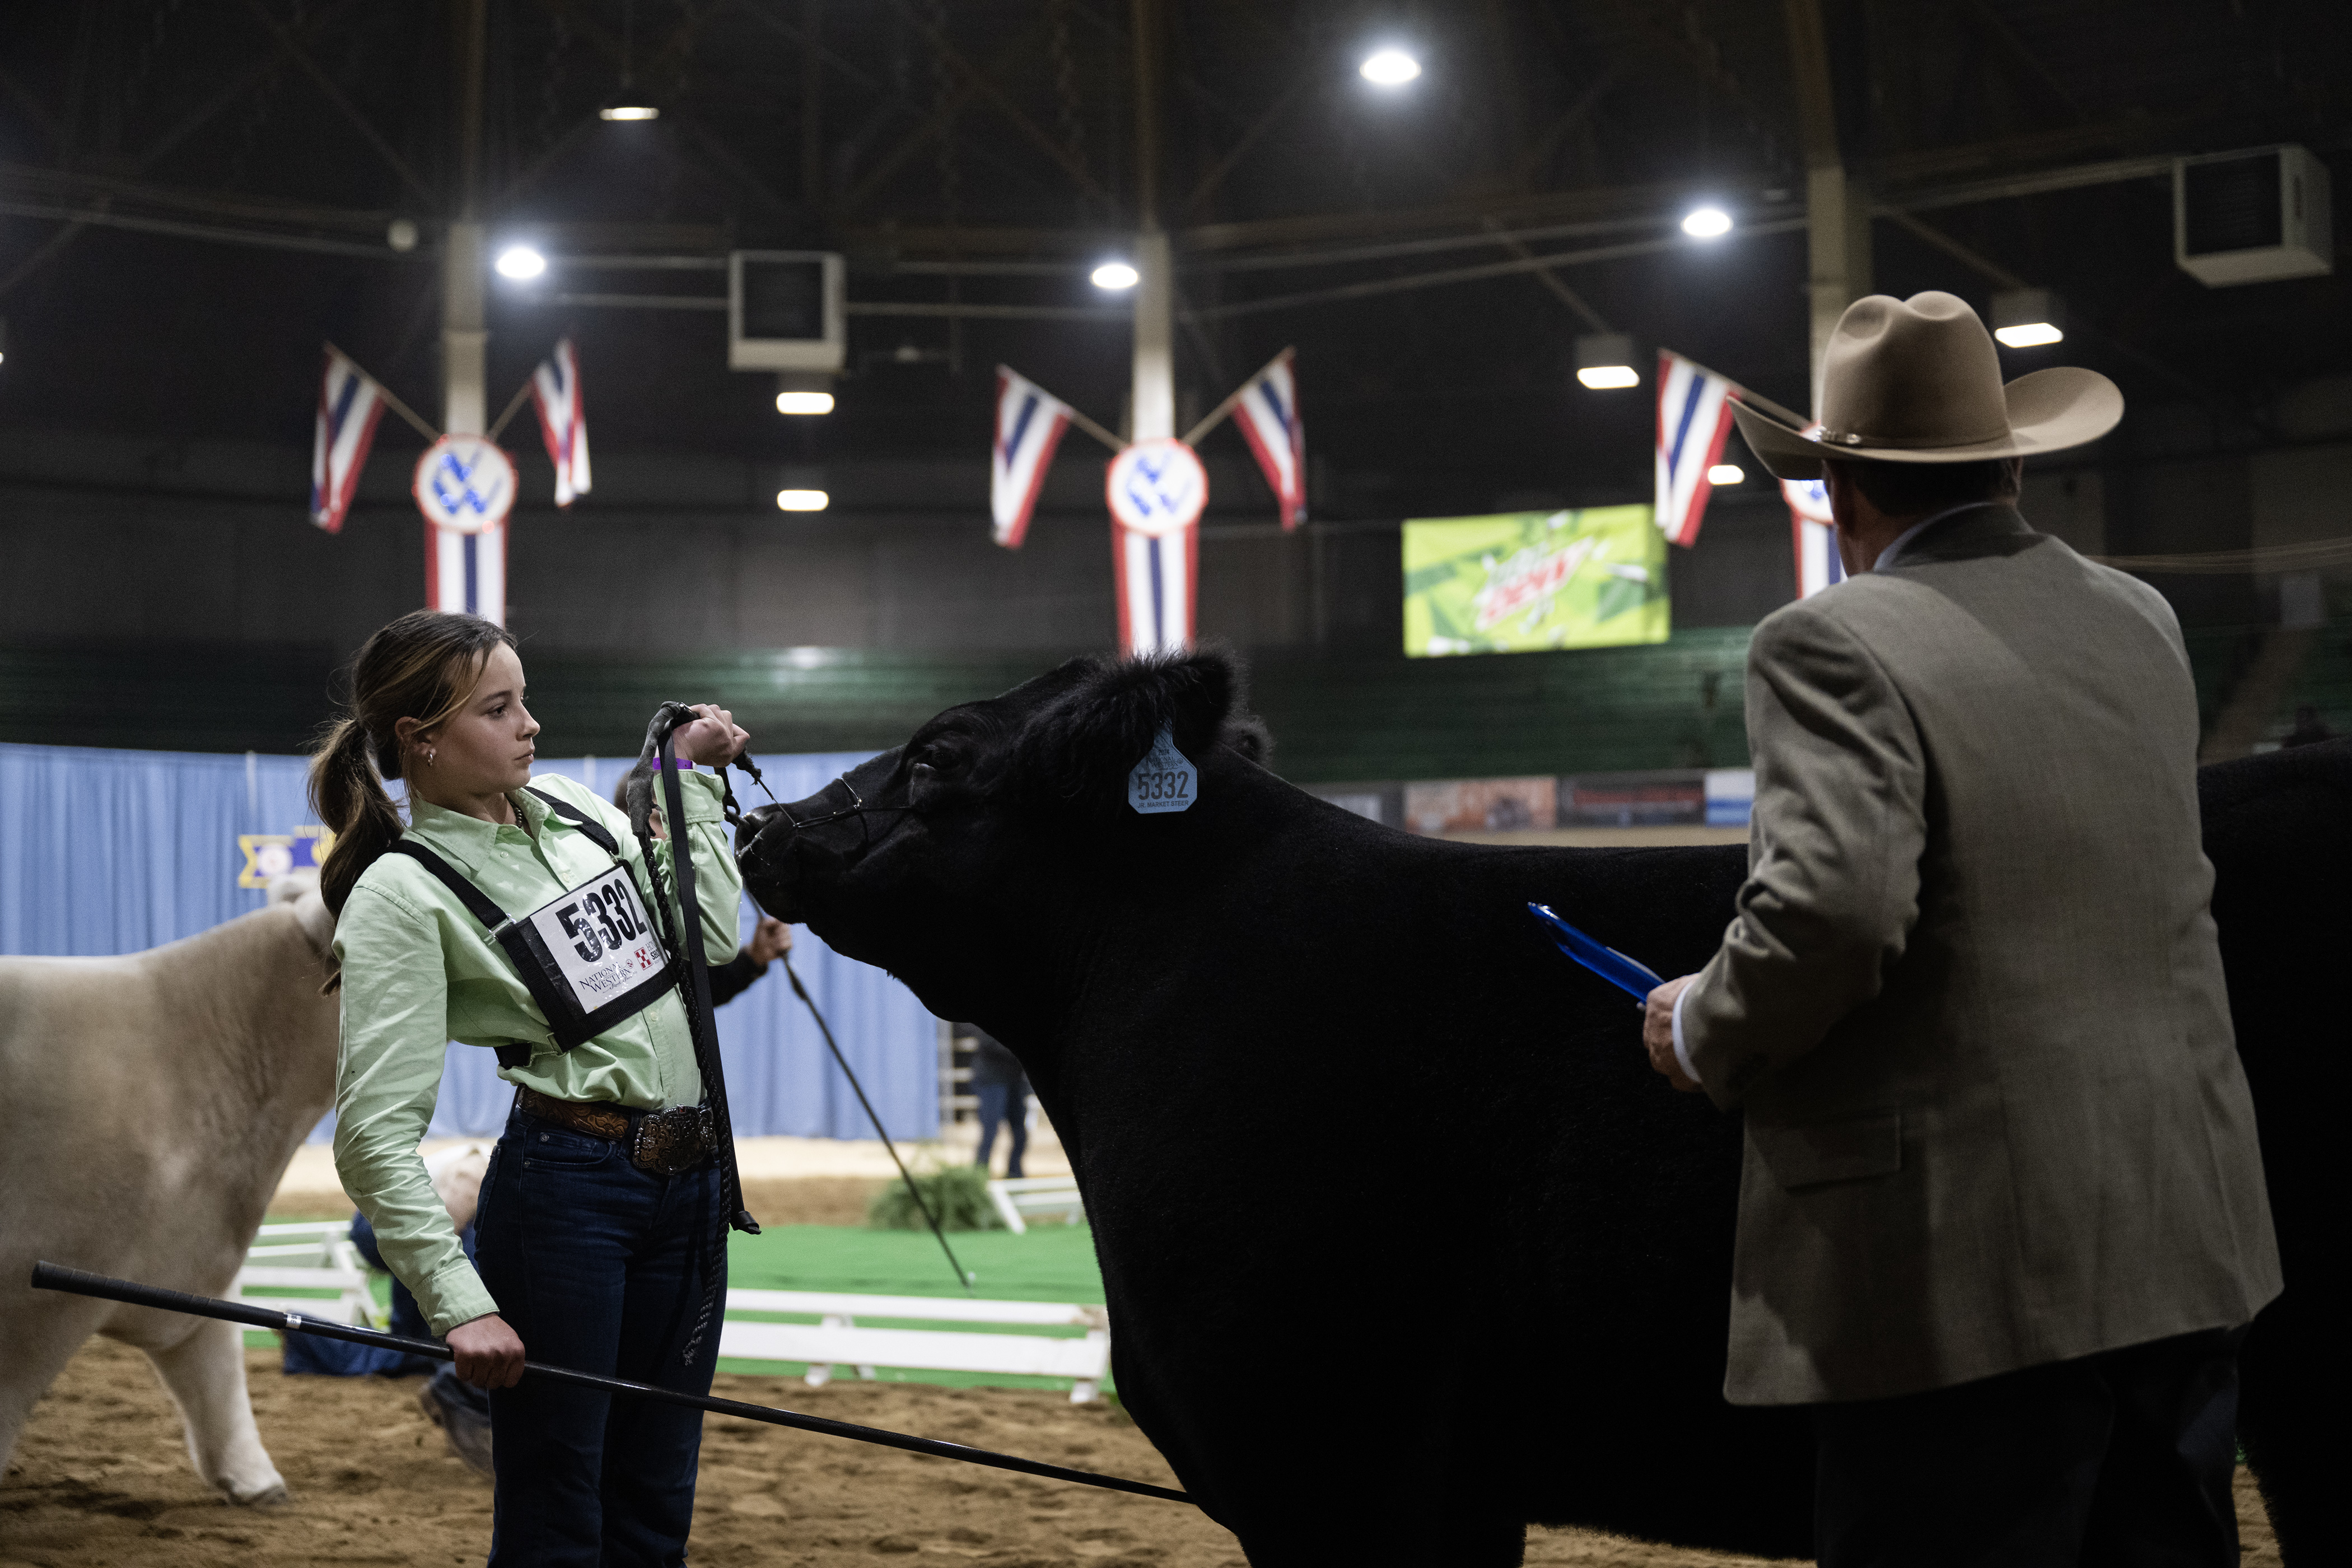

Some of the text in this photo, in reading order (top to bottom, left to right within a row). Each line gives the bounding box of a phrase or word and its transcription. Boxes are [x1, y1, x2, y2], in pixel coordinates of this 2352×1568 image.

[1138, 771, 1188, 800] 5332
[555, 879, 647, 962] 5332
[646, 940, 657, 951] HON
[650, 949, 660, 960] SHO
[578, 962, 623, 990] NATIONAL
[590, 969, 631, 992] WESTERN
